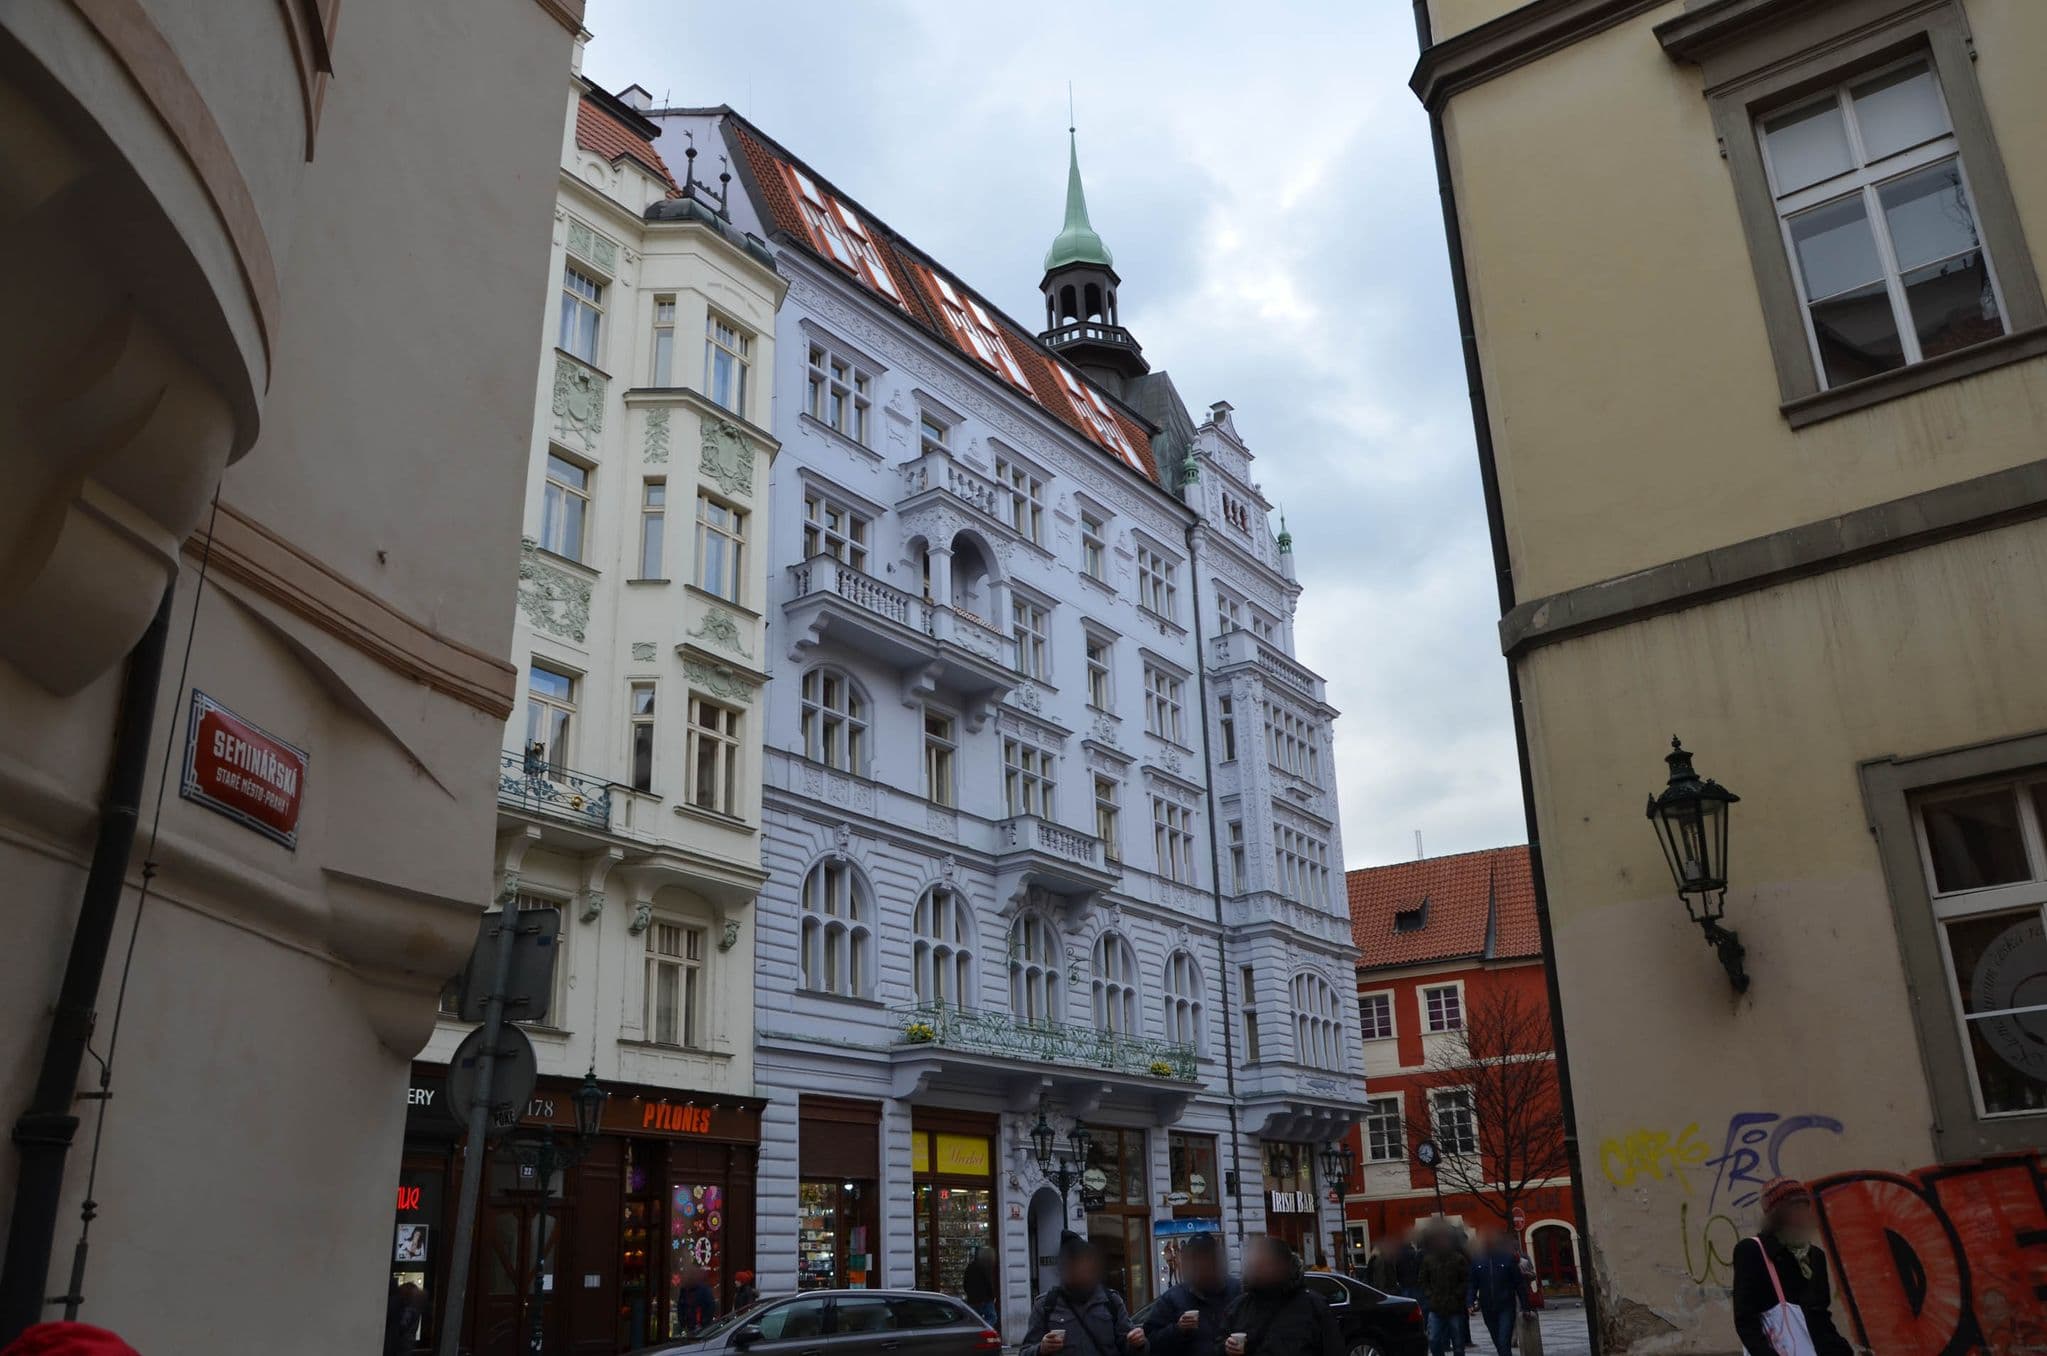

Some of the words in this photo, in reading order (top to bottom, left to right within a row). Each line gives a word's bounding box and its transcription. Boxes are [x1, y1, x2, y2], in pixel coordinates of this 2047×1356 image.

[213, 729, 298, 798] SEMINÁŘSKÁ
[216, 767, 242, 791] STARÉ
[527, 1099, 555, 1119] 178
[642, 1103, 711, 1135] PYLONES
[1271, 1190, 1296, 1213] IRISH
[1296, 1190, 1315, 1213] BAR
